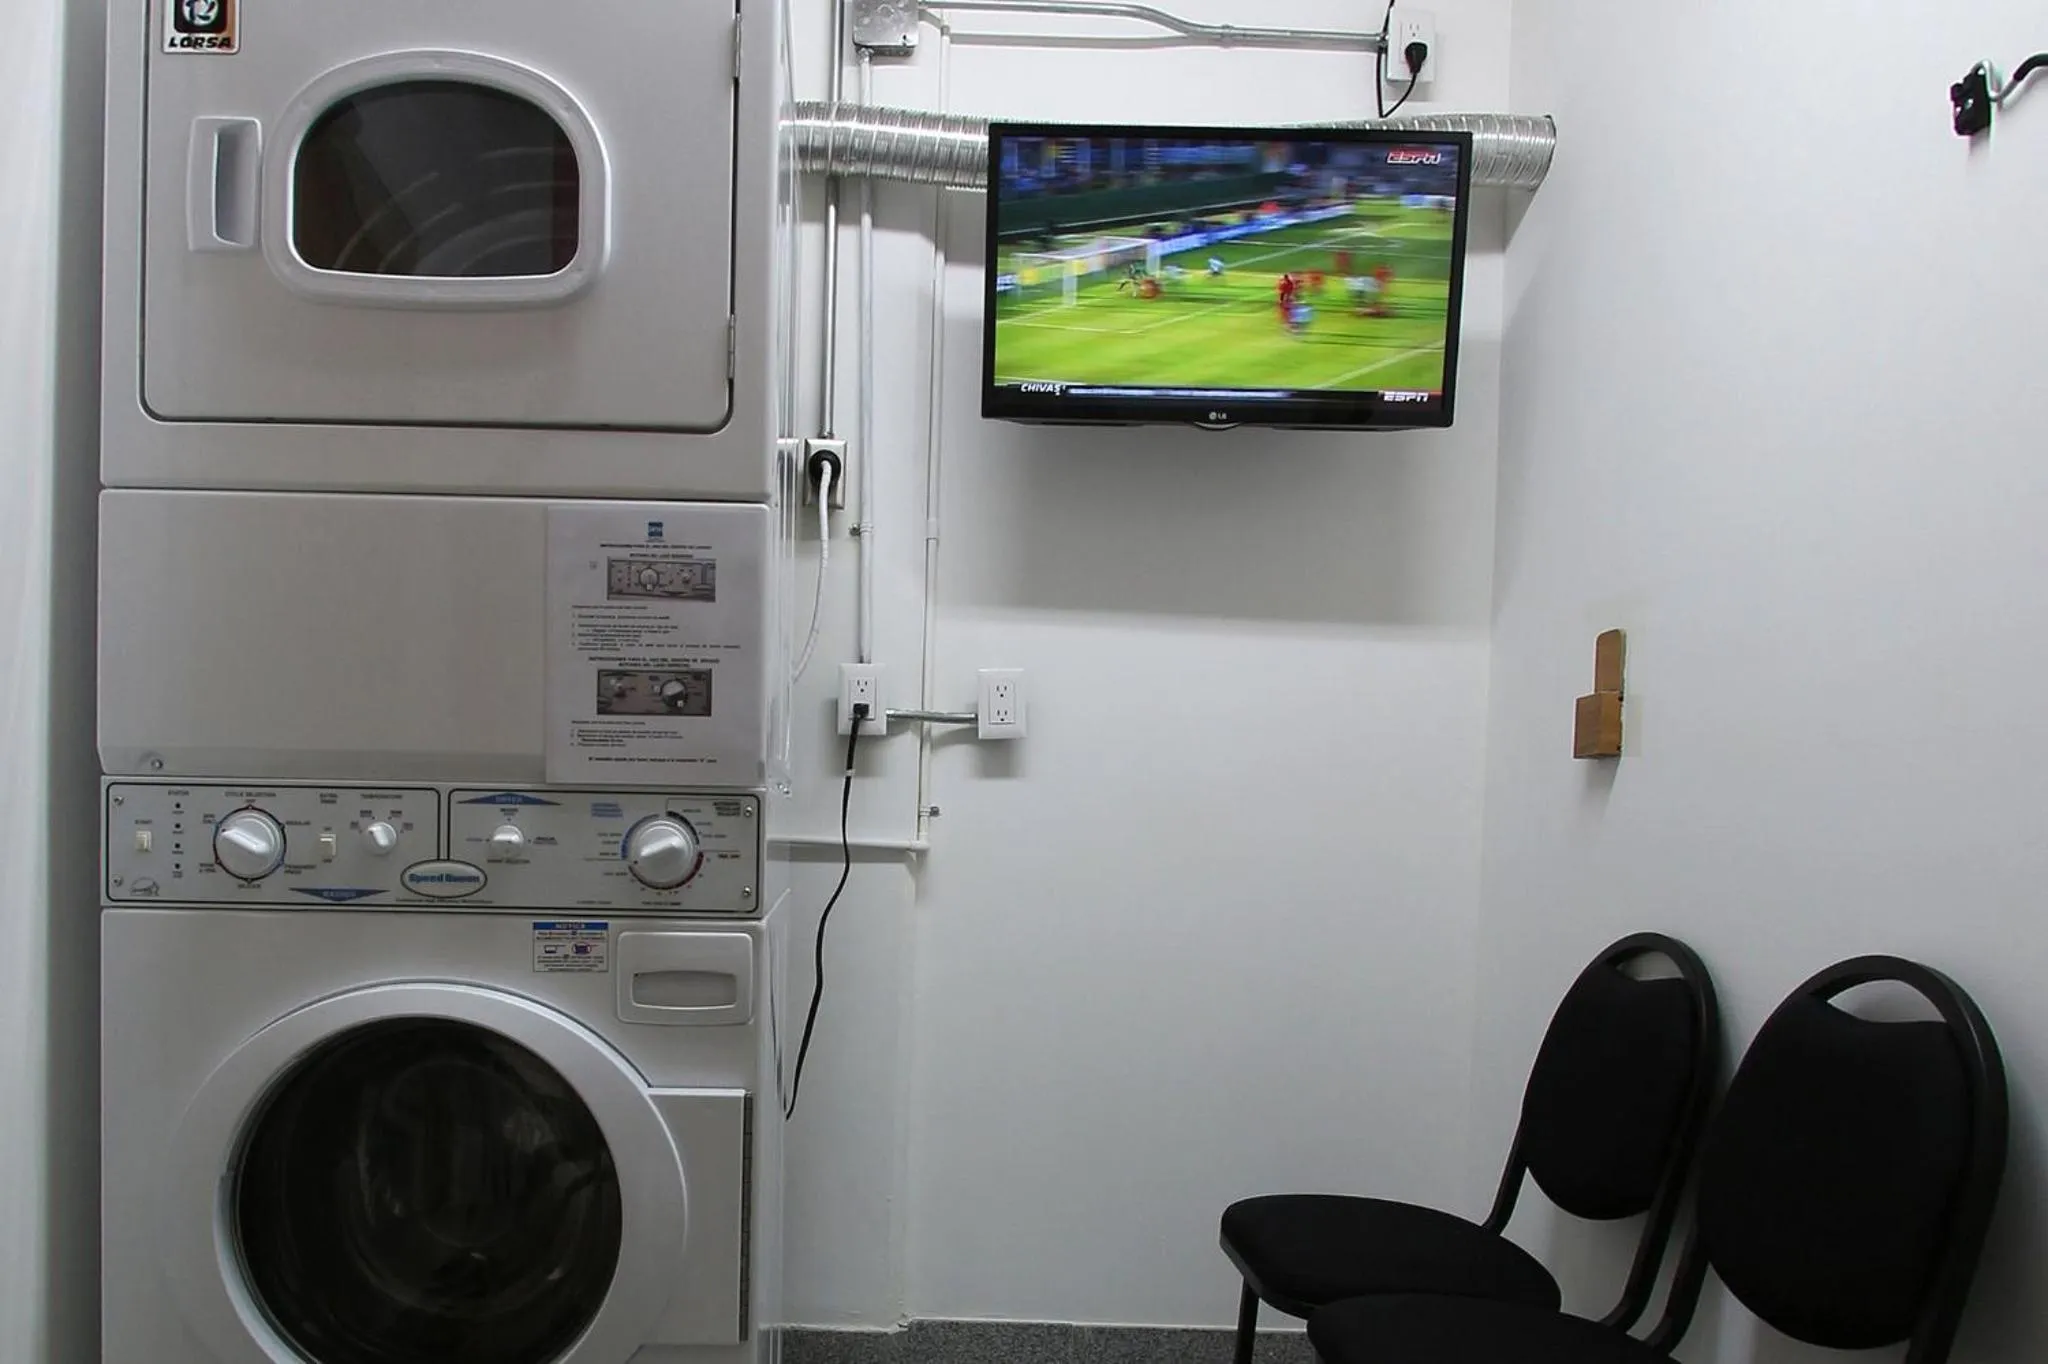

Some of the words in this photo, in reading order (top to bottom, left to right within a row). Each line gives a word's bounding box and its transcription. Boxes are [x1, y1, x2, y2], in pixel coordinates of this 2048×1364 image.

[168, 36, 233, 50] LORSA
[1383, 391, 1429, 402] ESPN
[408, 873, 443, 884] Speed
